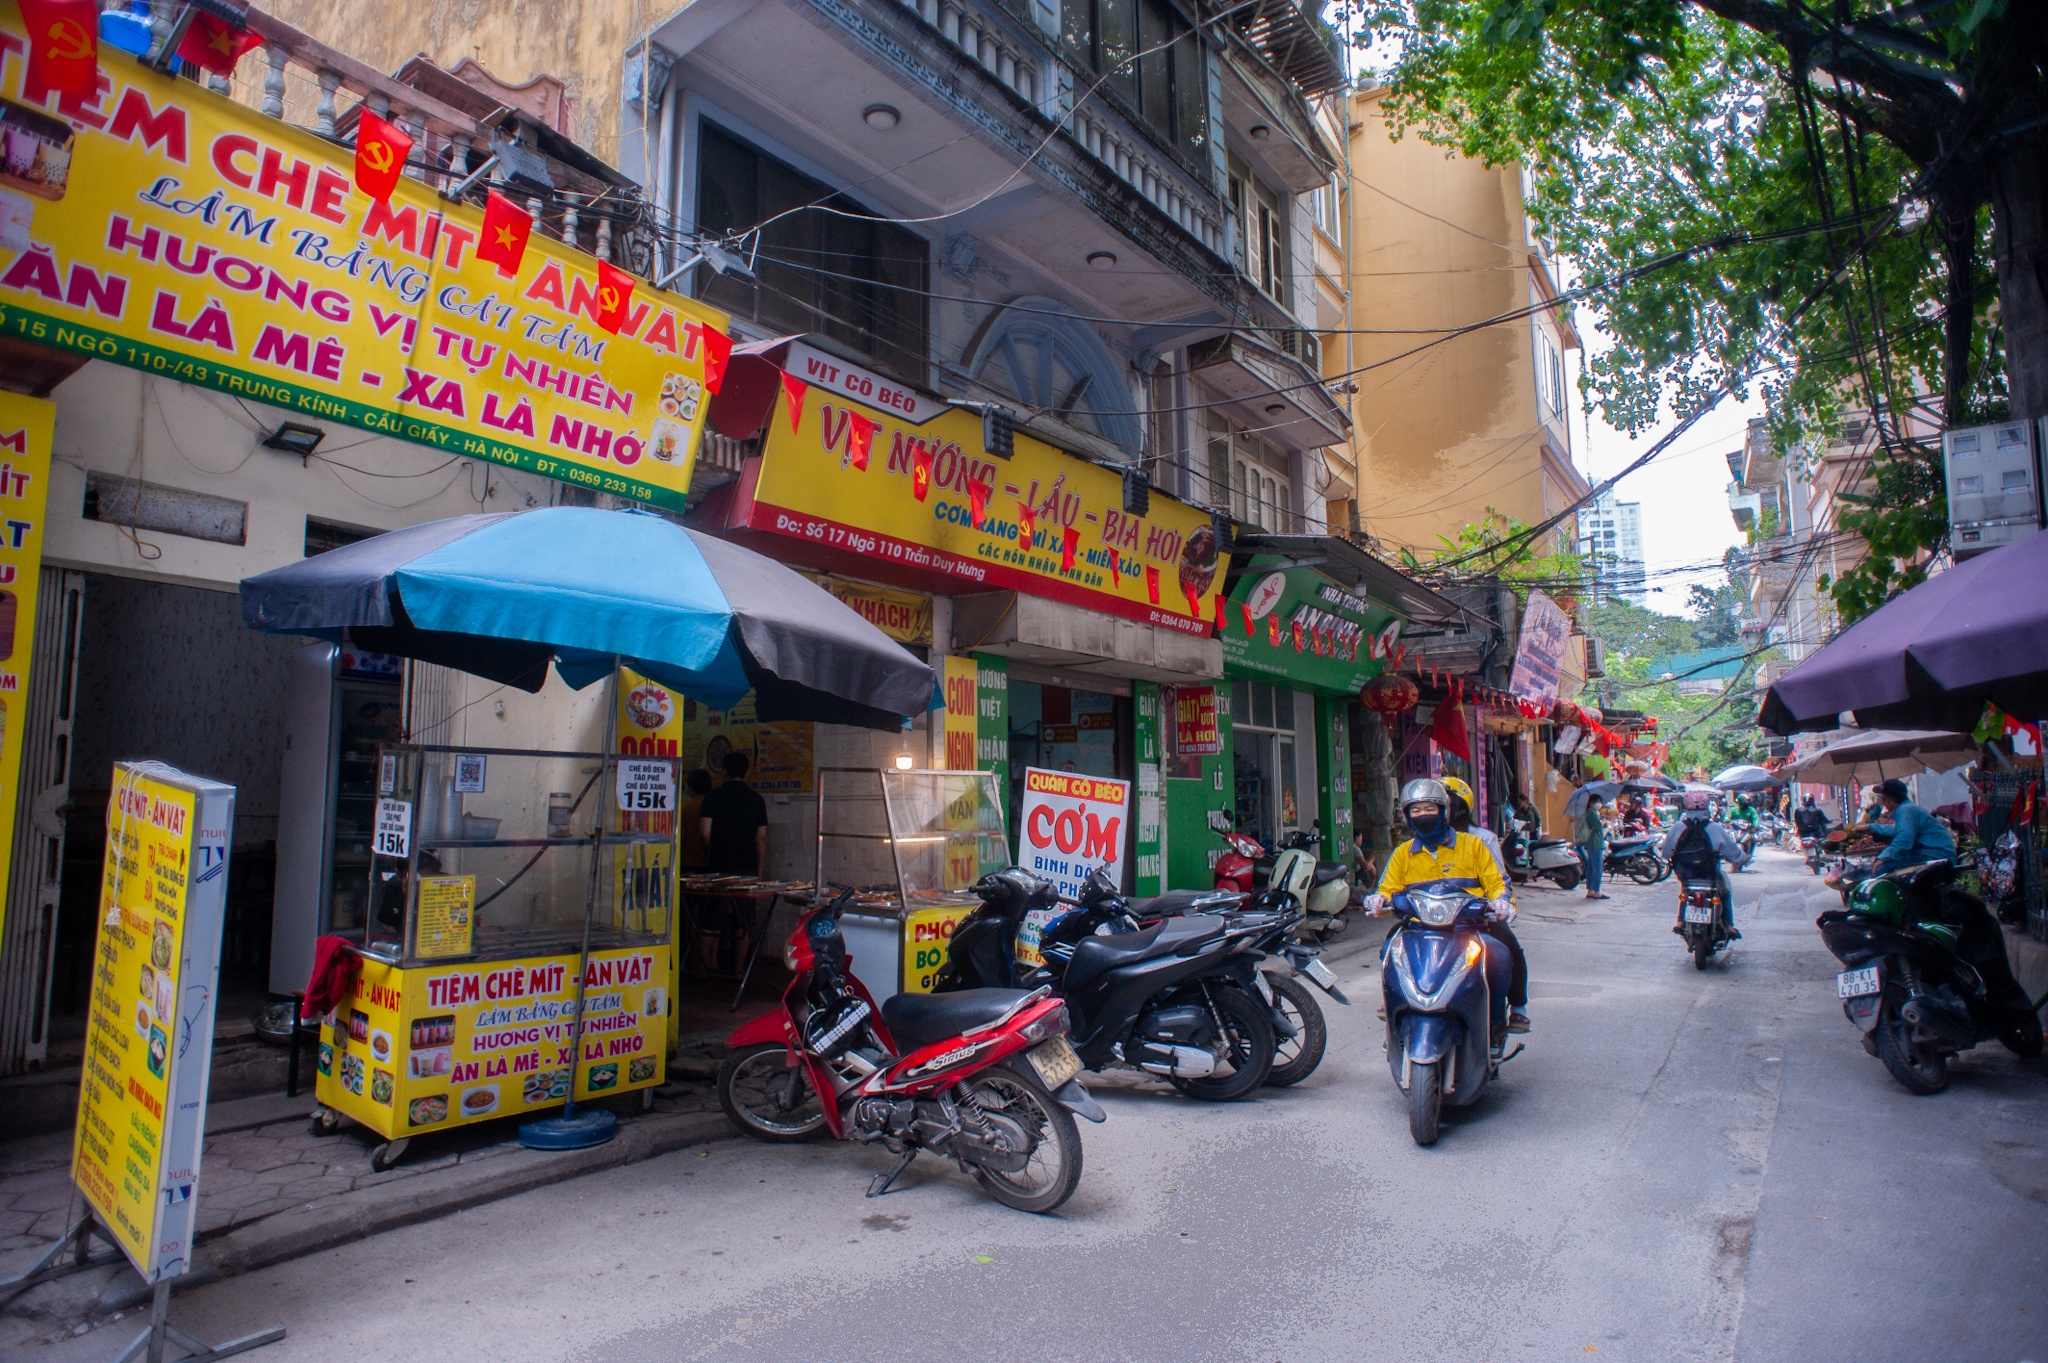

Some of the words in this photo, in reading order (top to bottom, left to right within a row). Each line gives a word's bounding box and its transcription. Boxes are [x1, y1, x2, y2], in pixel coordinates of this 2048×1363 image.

[211, 134, 349, 225] CHÈ
[362, 199, 474, 269] MÍT
[619, 303, 703, 360] VẶT
[140, 176, 280, 245] LÀM
[292, 227, 429, 302] BẰNG
[439, 286, 517, 331] CÁI
[523, 314, 606, 364] TÂM
[108, 212, 353, 324] HƯƠNG
[367, 300, 417, 356] VỊ
[432, 325, 497, 375] TỰ
[504, 350, 636, 418] NHIÊN
[0, 241, 128, 320] ĂN
[151, 289, 236, 354] LÀ
[252, 323, 347, 384] MÊ
[398, 366, 468, 419] XA
[480, 393, 537, 439] LÀ
[549, 413, 646, 466] NHỚ
[807, 357, 840, 383] VỊT
[845, 374, 872, 397] CÔ
[877, 383, 916, 414] BÉO
[17, 316, 47, 339] 15
[56, 327, 119, 357] NGÕ
[216, 369, 291, 403] TRUNG
[298, 393, 347, 420] KÍNH
[363, 404, 401, 434] CẦU
[407, 420, 449, 445] GIẤY
[463, 437, 487, 455] HÀ
[491, 443, 519, 465] NỘI
[569, 467, 601, 487] 0369
[604, 476, 627, 493] 233
[629, 484, 652, 500] 158
[1027, 473, 1080, 528] LẨU
[1102, 507, 1140, 552] BIA
[1145, 524, 1182, 566] HƠI
[777, 515, 802, 533] Đc:
[805, 522, 825, 539] Số
[828, 528, 842, 543] 17
[848, 532, 875, 553] Ngõ
[879, 541, 902, 558] 110
[904, 544, 930, 565] Trần
[932, 554, 954, 574] Duy
[956, 561, 986, 582] Hưng
[935, 502, 974, 528] CƠM
[1031, 528, 1048, 549] MÌ
[1118, 557, 1141, 577] XÀO
[978, 543, 999, 559] CÁC
[1003, 549, 1025, 565] MÓN
[1028, 556, 1056, 575] NHẬU
[1084, 571, 1103, 587] DÂN
[853, 598, 910, 630] KHÁCH
[1161, 613, 1178, 627] 0364
[1179, 618, 1191, 629] 070
[1191, 620, 1203, 633] 789
[947, 675, 975, 716] CƠM
[981, 696, 1001, 720] VIỆT
[1139, 694, 1156, 720] GIẶT
[977, 735, 1007, 764] NHẬN
[1144, 734, 1154, 759] LÀ
[1196, 730, 1216, 742] HƠI
[624, 791, 667, 809] 15k
[1029, 774, 1067, 793] QUÁN
[1071, 779, 1091, 796] CÔ
[1095, 782, 1123, 801] BÉO
[152, 795, 165, 827] ĂN
[166, 799, 185, 839] VẶT
[1028, 802, 1121, 863] CƠM
[379, 832, 404, 854] 15k
[1034, 855, 1068, 875] BÌNH
[1853, 902, 1870, 911] Grab
[915, 916, 956, 943] PHỞ
[429, 972, 480, 1008] TIỆM
[485, 967, 525, 1000] CHÈ
[529, 964, 565, 995] MÍT
[585, 957, 613, 987] ĂN
[616, 955, 651, 986] VẶT
[1841, 981, 1877, 996] 420.35
[1843, 970, 1872, 985] 88-K1
[476, 1009, 512, 1027] LÀM
[516, 1001, 558, 1020] BẰNG
[473, 1028, 540, 1050] HƯƠNG
[544, 1025, 560, 1042] VỊ
[590, 1013, 637, 1032] NHIÊN
[450, 1061, 480, 1084] ĂN
[486, 1055, 508, 1078] LÀ
[513, 1049, 540, 1072] MÊ
[585, 1040, 603, 1061] LÀ
[609, 1032, 645, 1056] NHỚ
[1042, 1053, 1080, 1085] 523.58
